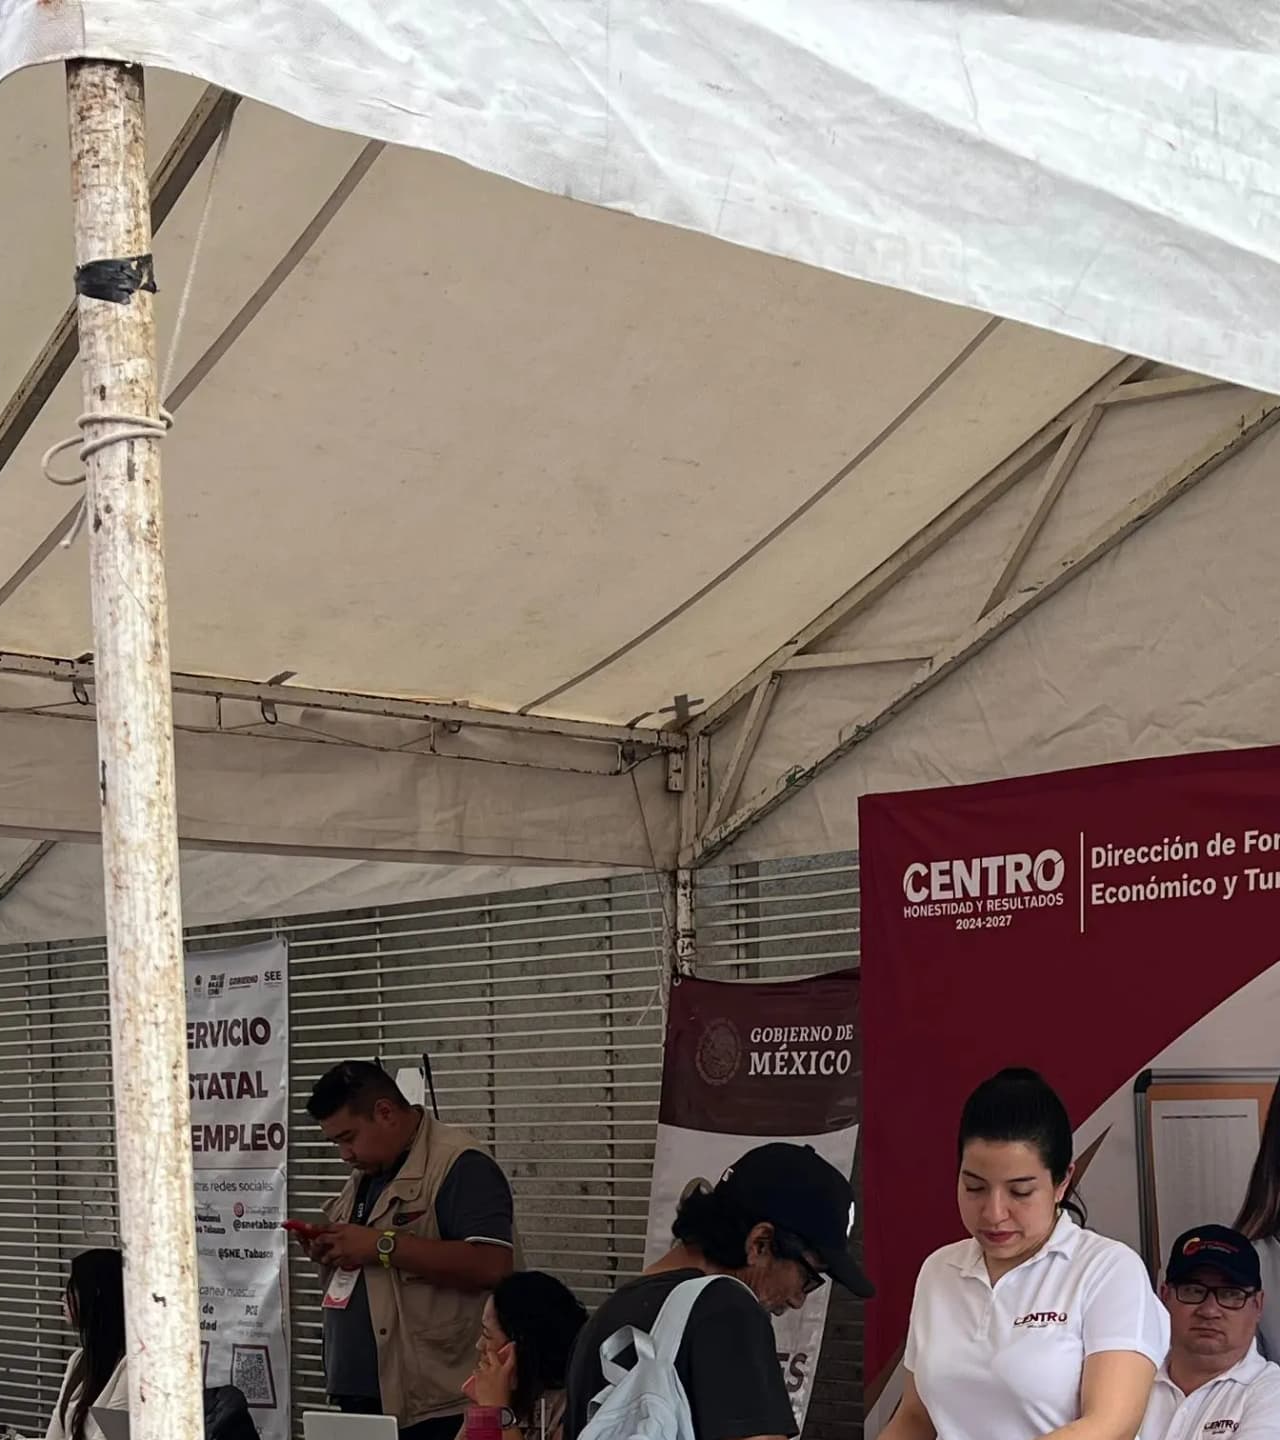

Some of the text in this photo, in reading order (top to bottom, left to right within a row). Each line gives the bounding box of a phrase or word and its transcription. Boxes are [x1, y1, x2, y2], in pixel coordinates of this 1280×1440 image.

[1091, 836, 1199, 868] Dirección
[1206, 832, 1236, 857] de
[903, 849, 1065, 903] CENTRO
[1091, 874, 1217, 905] Económico
[1222, 873, 1238, 899] y
[904, 893, 1064, 918] HONESTIDAD Y RESULTADOS
[956, 915, 1013, 931] 2024-2027
[186, 1017, 271, 1049] ERVICIO
[750, 1024, 854, 1043] GOBIERNO DE
[748, 1043, 852, 1075] MÉXICO
[189, 1070, 269, 1100] STATAL
[191, 1123, 285, 1152] EMPLEO
[211, 1180, 237, 1192] redes
[202, 1303, 214, 1314] de
[1014, 1312, 1067, 1326] CENTRO
